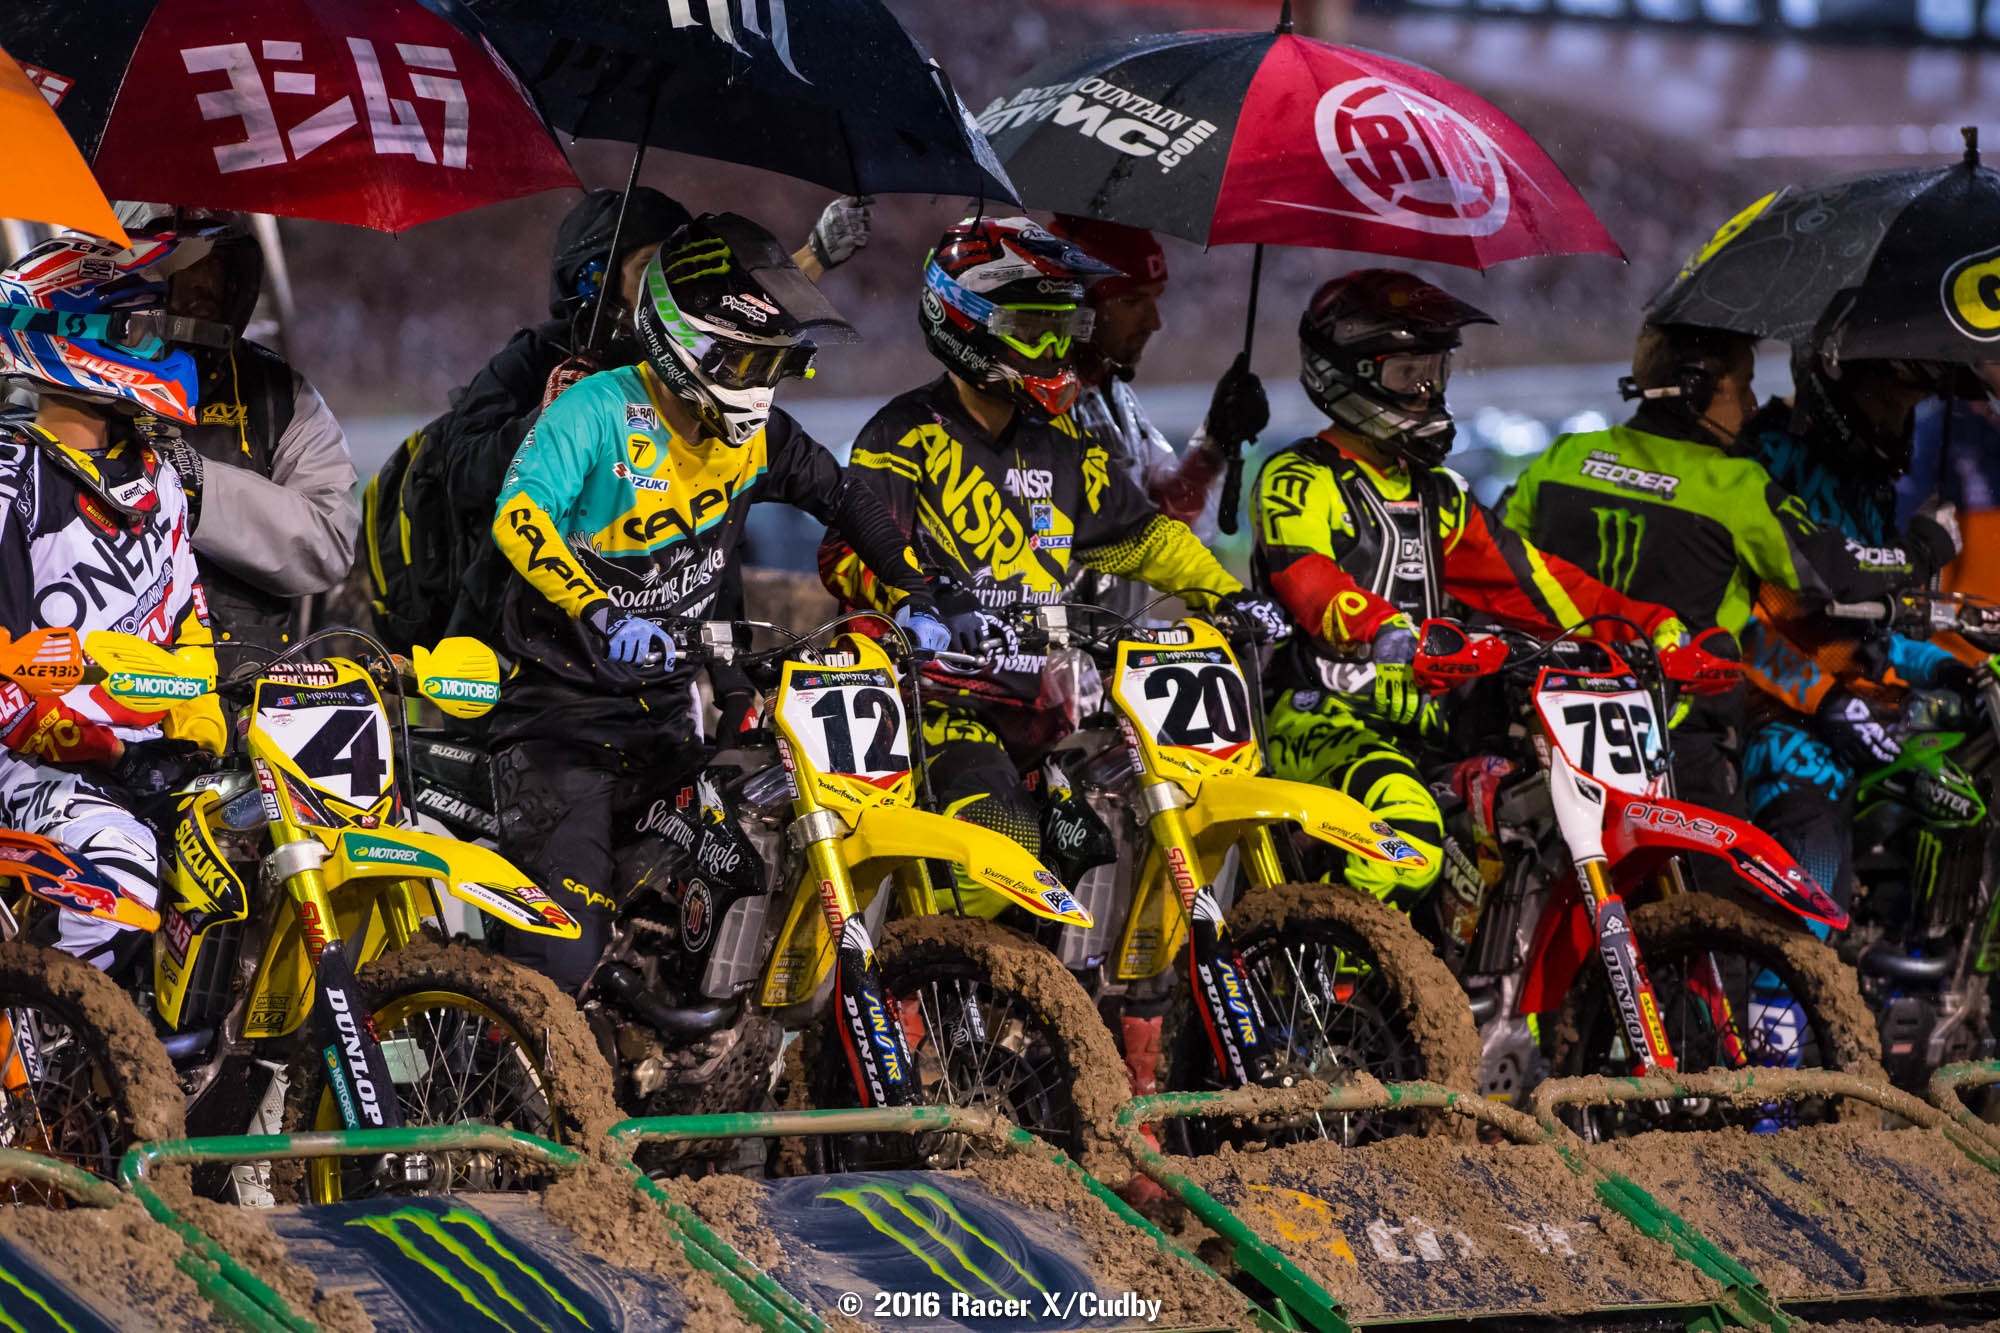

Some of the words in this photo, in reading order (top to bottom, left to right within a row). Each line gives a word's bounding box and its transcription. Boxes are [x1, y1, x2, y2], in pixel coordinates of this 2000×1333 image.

[632, 438, 650, 463] 7
[632, 476, 669, 491] ZUKI
[1040, 536, 1072, 547] SUZU
[135, 677, 201, 696] MOTOREX
[440, 679, 499, 699] MOTOREX
[1144, 665, 1251, 745] 20
[811, 688, 910, 774] 12
[292, 709, 387, 797] 4
[175, 818, 231, 899] SUZUKI
[368, 846, 421, 862] MOTOREX
[325, 987, 383, 1127] DUNLOP
[331, 1067, 359, 1129] MOTOREX
